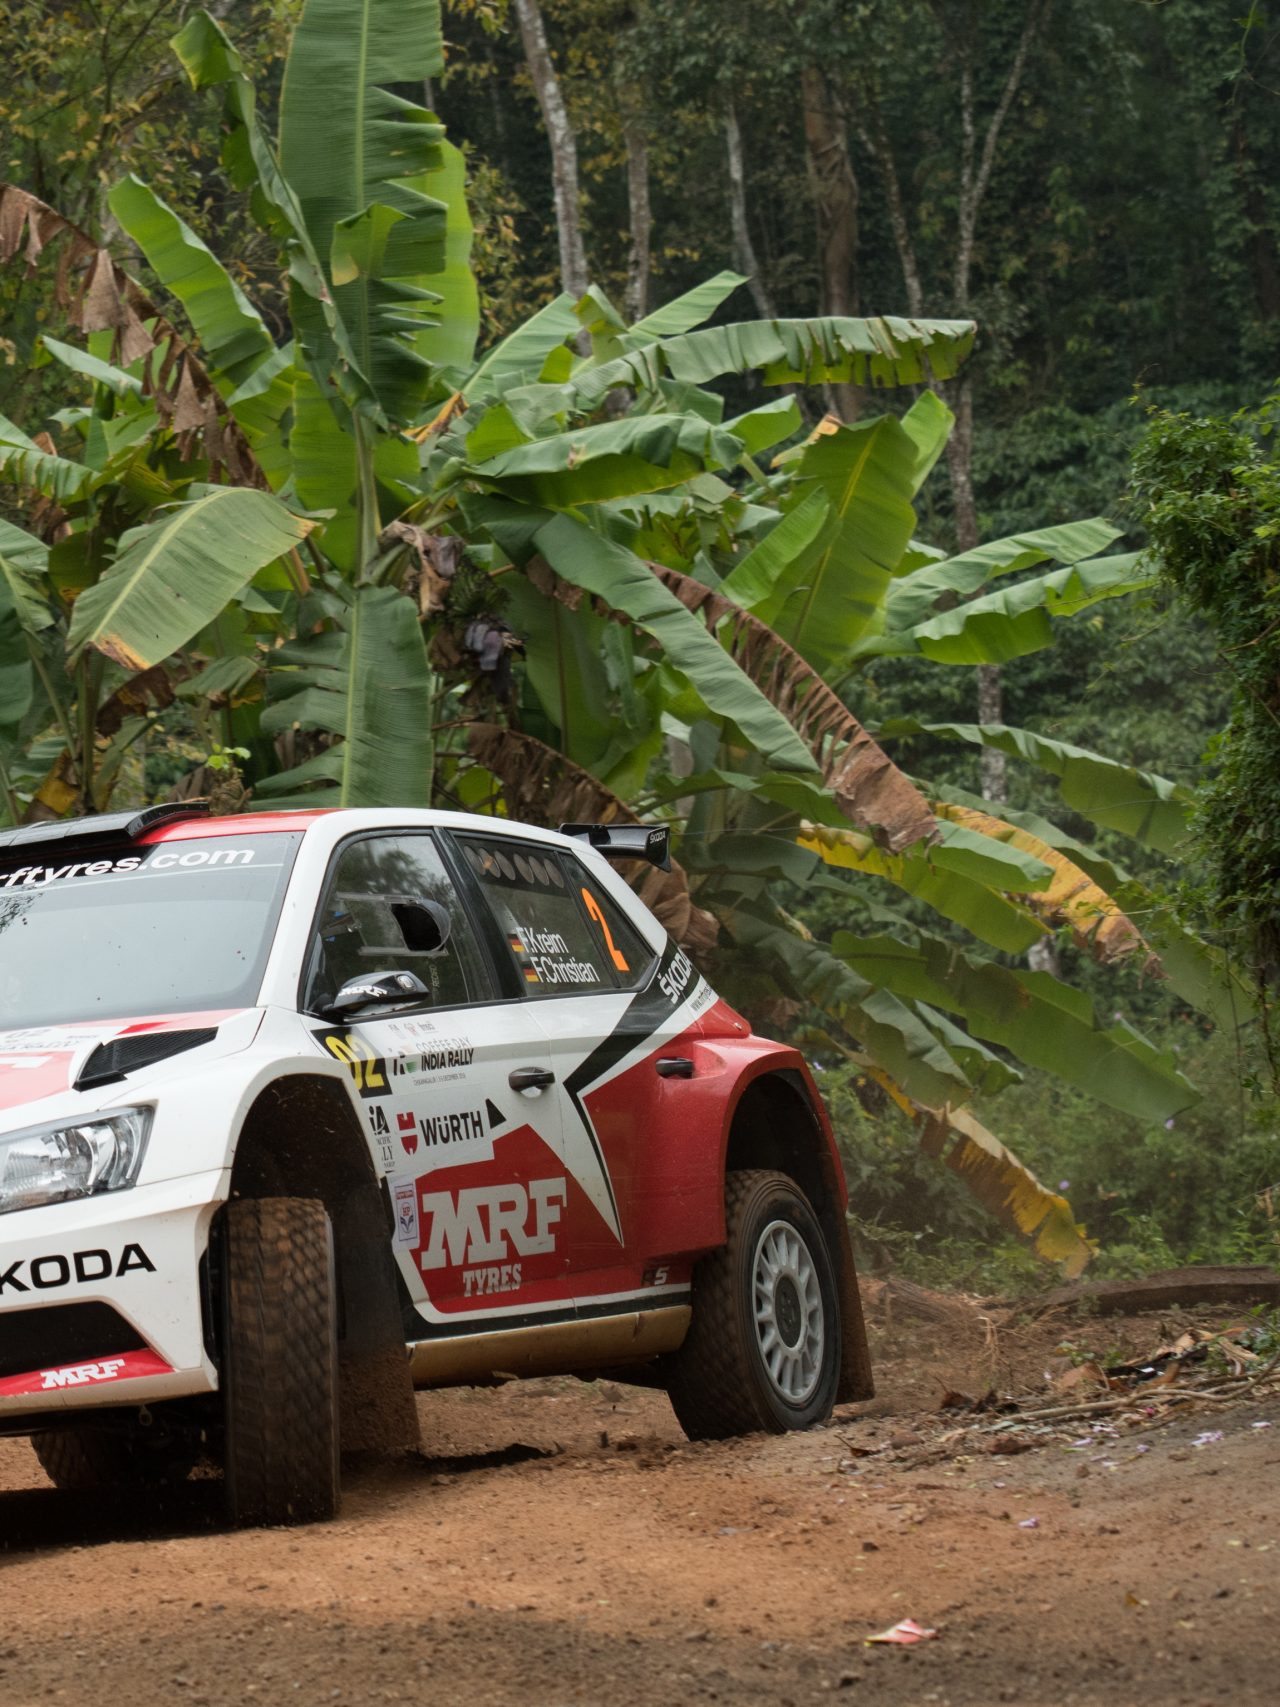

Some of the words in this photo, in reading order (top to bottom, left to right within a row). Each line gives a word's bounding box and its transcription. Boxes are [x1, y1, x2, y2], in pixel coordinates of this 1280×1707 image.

[581, 886, 630, 972] 2
[325, 1033, 385, 1090] 02
[421, 1052, 446, 1072] INDIA
[448, 1048, 474, 1068] RALLY
[419, 1110, 484, 1147] WÜRTH
[421, 1176, 568, 1271] MRF
[462, 1263, 522, 1298] TYRES
[41, 1358, 126, 1390] MRF
